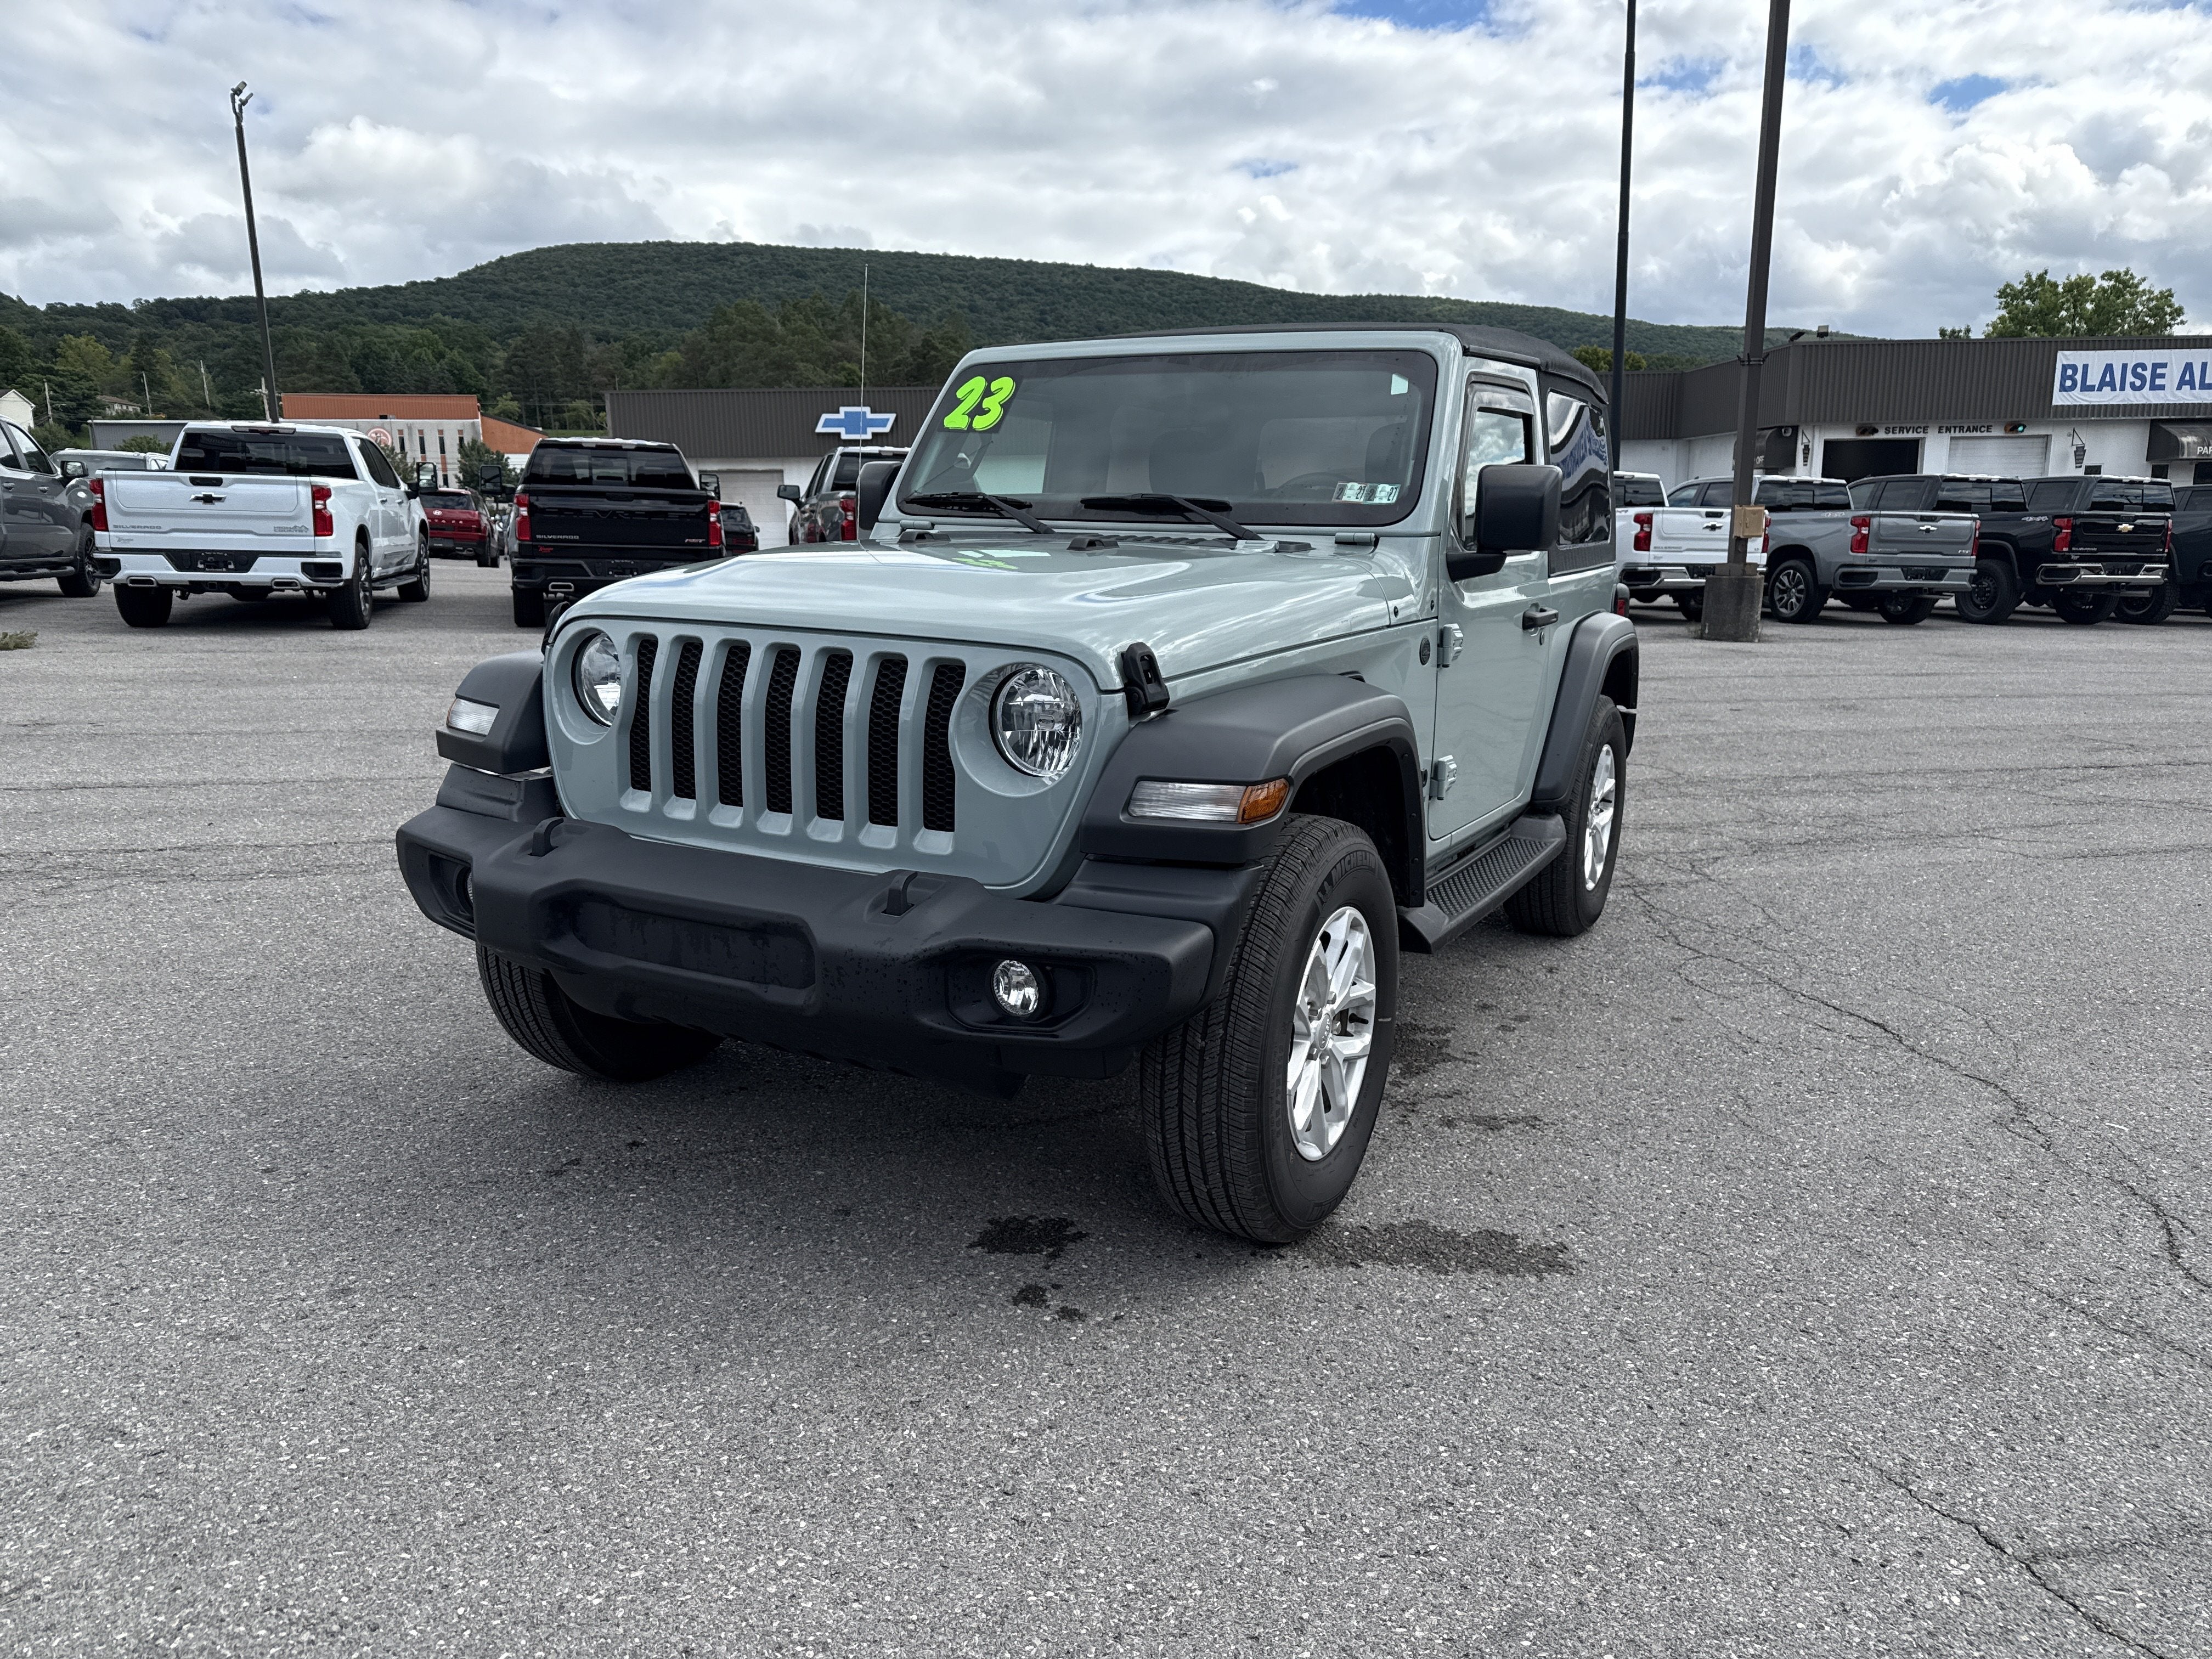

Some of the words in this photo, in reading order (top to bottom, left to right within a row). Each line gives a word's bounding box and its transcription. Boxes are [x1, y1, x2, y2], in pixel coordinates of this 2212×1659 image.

[2059, 362, 2168, 392] BLAISE
[944, 376, 1016, 431] 23
[1884, 426, 1929, 435] SERVICE
[1938, 425, 1993, 434] ENTRANCE
[1331, 850, 1375, 885] MICHELIN
